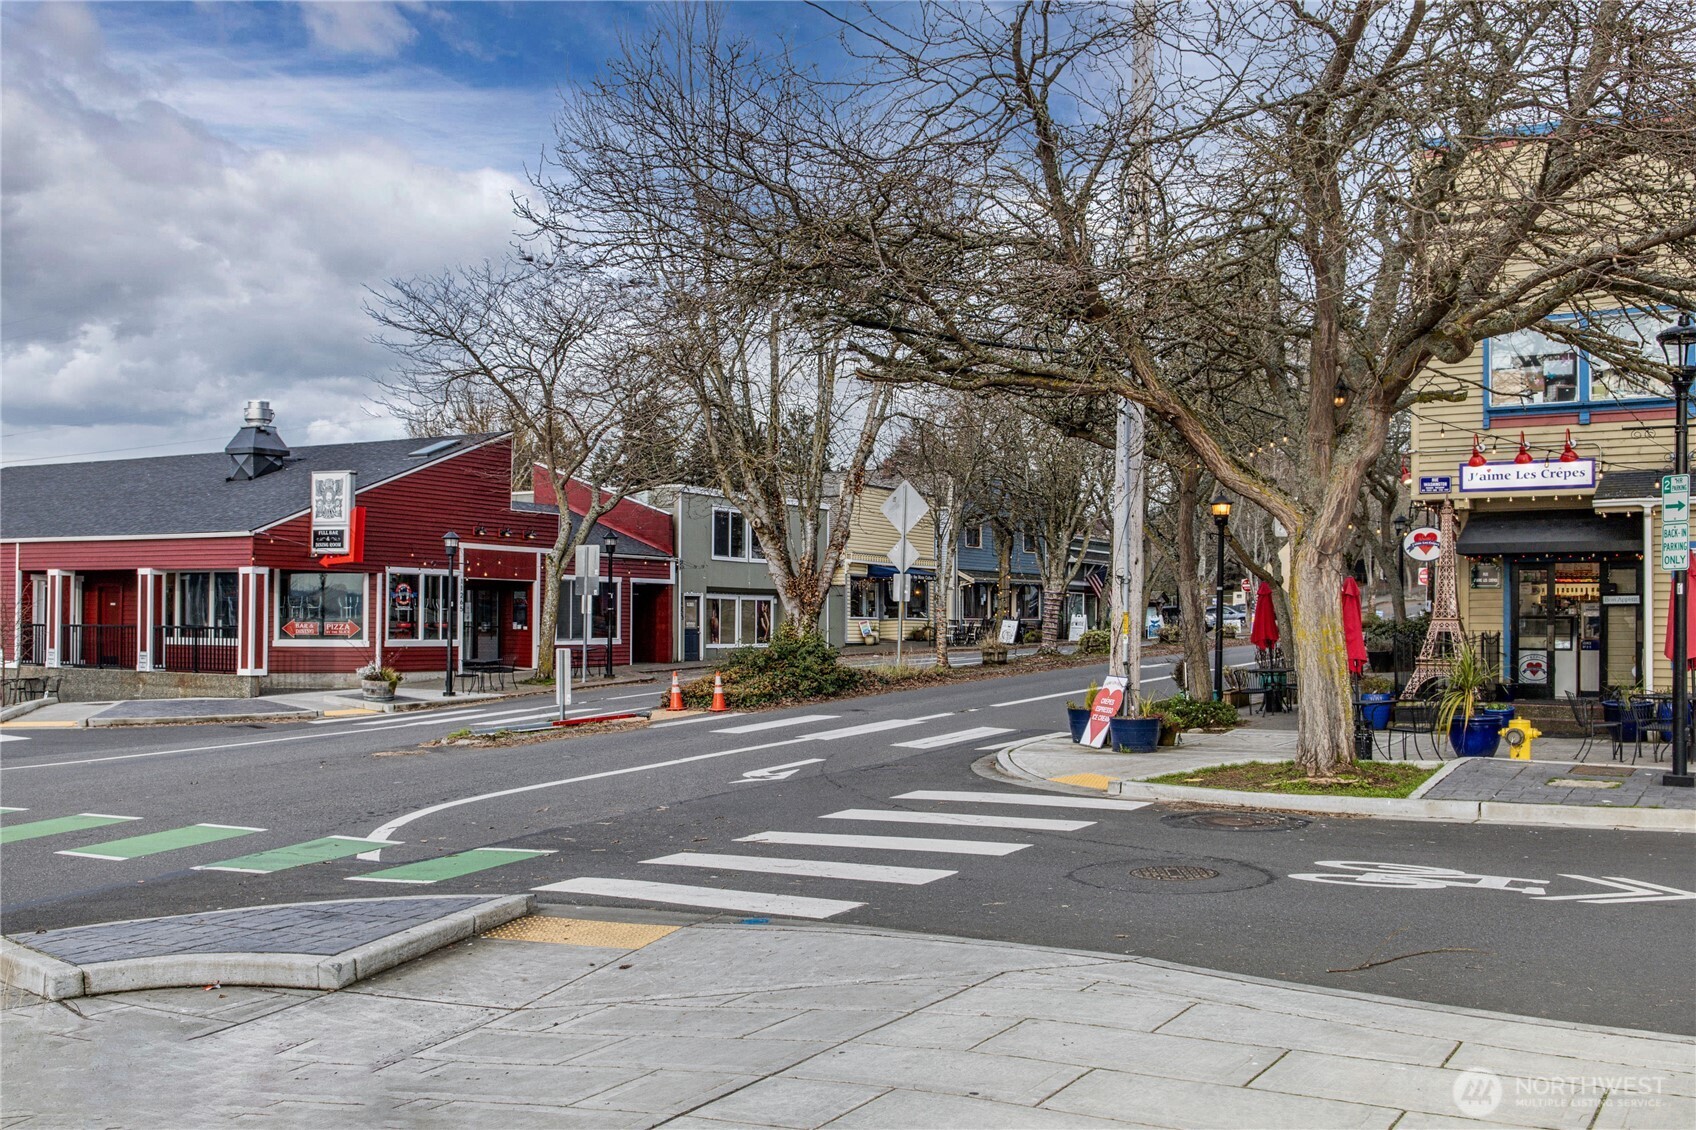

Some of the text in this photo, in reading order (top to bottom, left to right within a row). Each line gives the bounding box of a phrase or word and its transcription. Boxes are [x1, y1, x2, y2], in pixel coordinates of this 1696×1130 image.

[1468, 467, 1586, 482] J'aime Les Crêpes
[1664, 480, 1671, 490] 2
[1671, 484, 1687, 492] PARKING
[1664, 541, 1687, 552] PARKING
[1664, 555, 1686, 565] ONLY
[1094, 706, 1113, 714] ESPRESSO
[1098, 714, 1110, 722] CREAM
